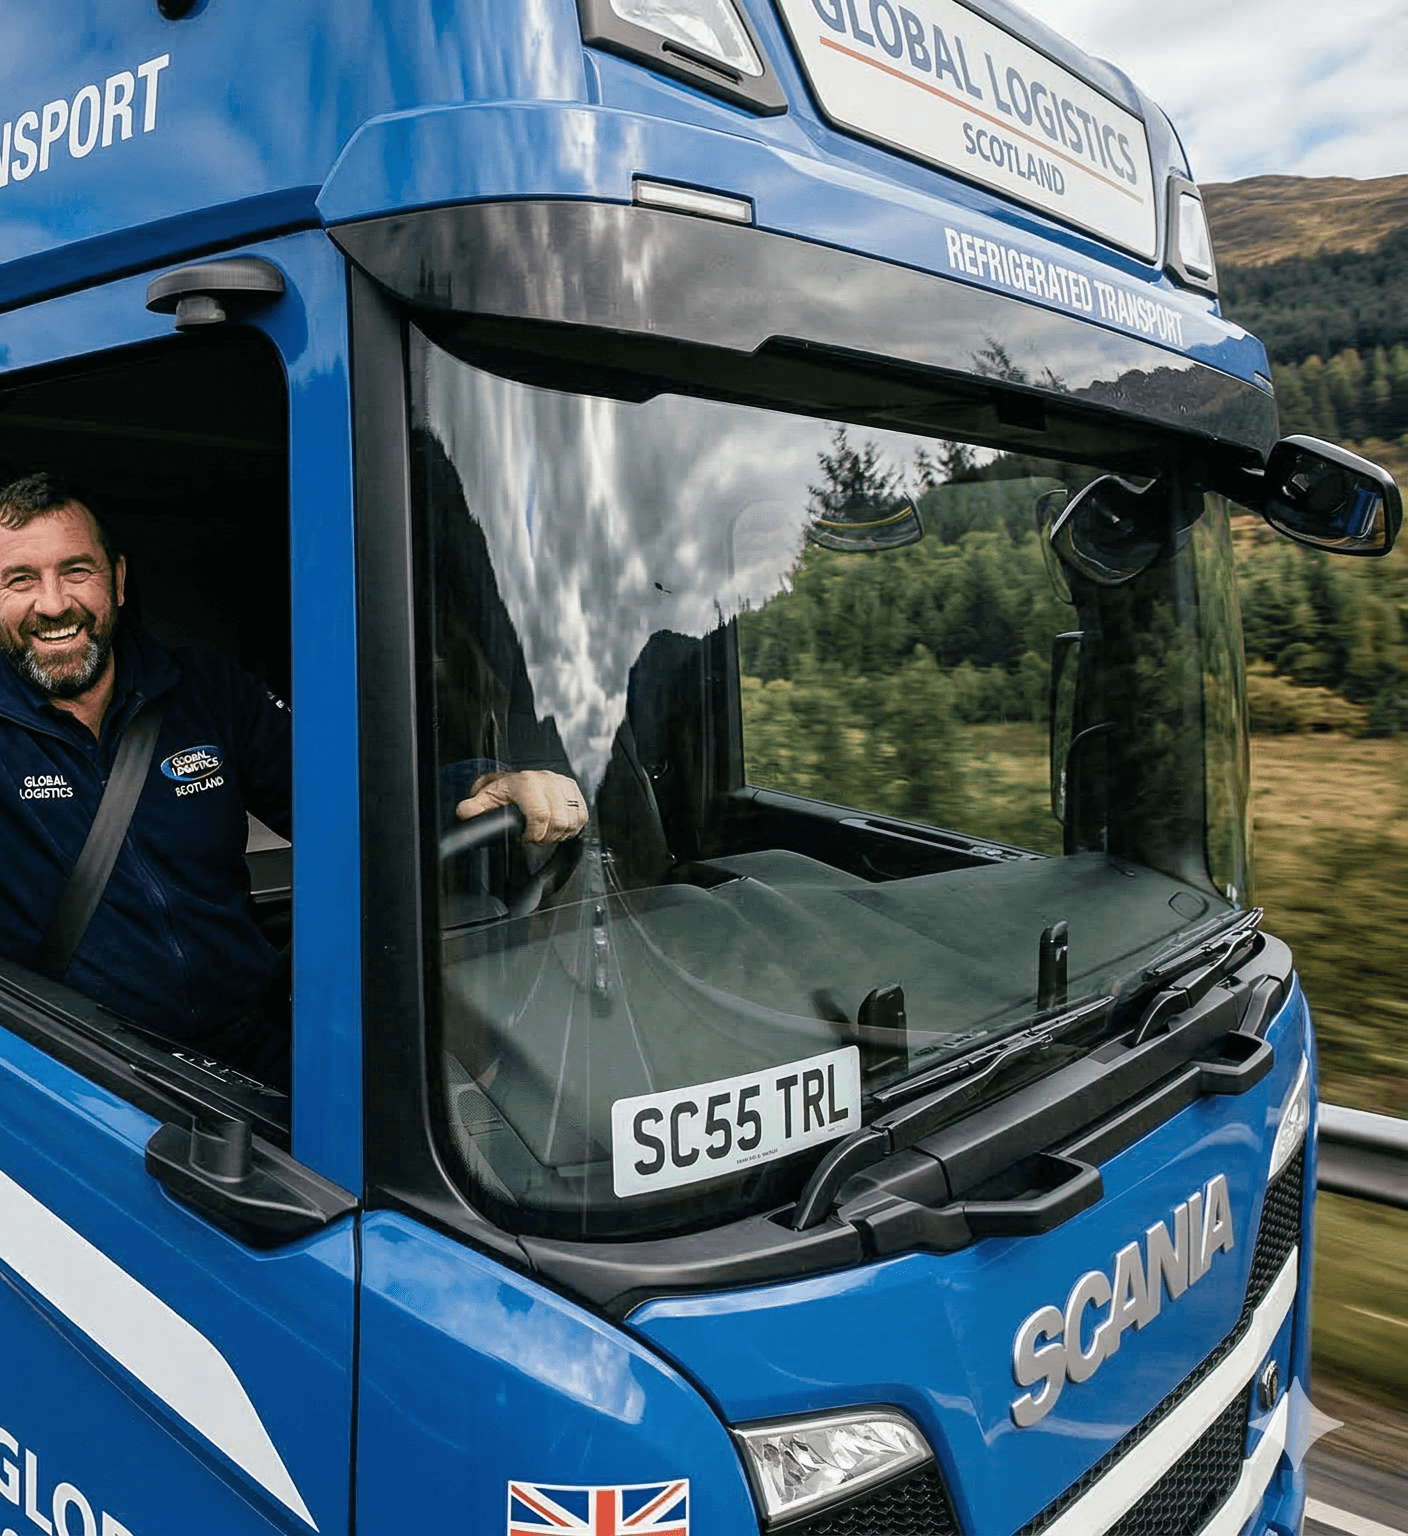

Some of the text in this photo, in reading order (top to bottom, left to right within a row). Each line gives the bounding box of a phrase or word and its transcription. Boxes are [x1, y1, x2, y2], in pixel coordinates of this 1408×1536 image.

[962, 121, 1065, 196] SCOTLAND
[984, 52, 1137, 185] LOGISTICS
[944, 227, 1184, 348] REFRIGERATED TRANSPORT
[19, 786, 74, 800] LOGISTICS
[23, 774, 68, 788] GLOBAL
[633, 1063, 849, 1176] SC55 TRL
[1011, 1173, 1235, 1428] SCANIA
